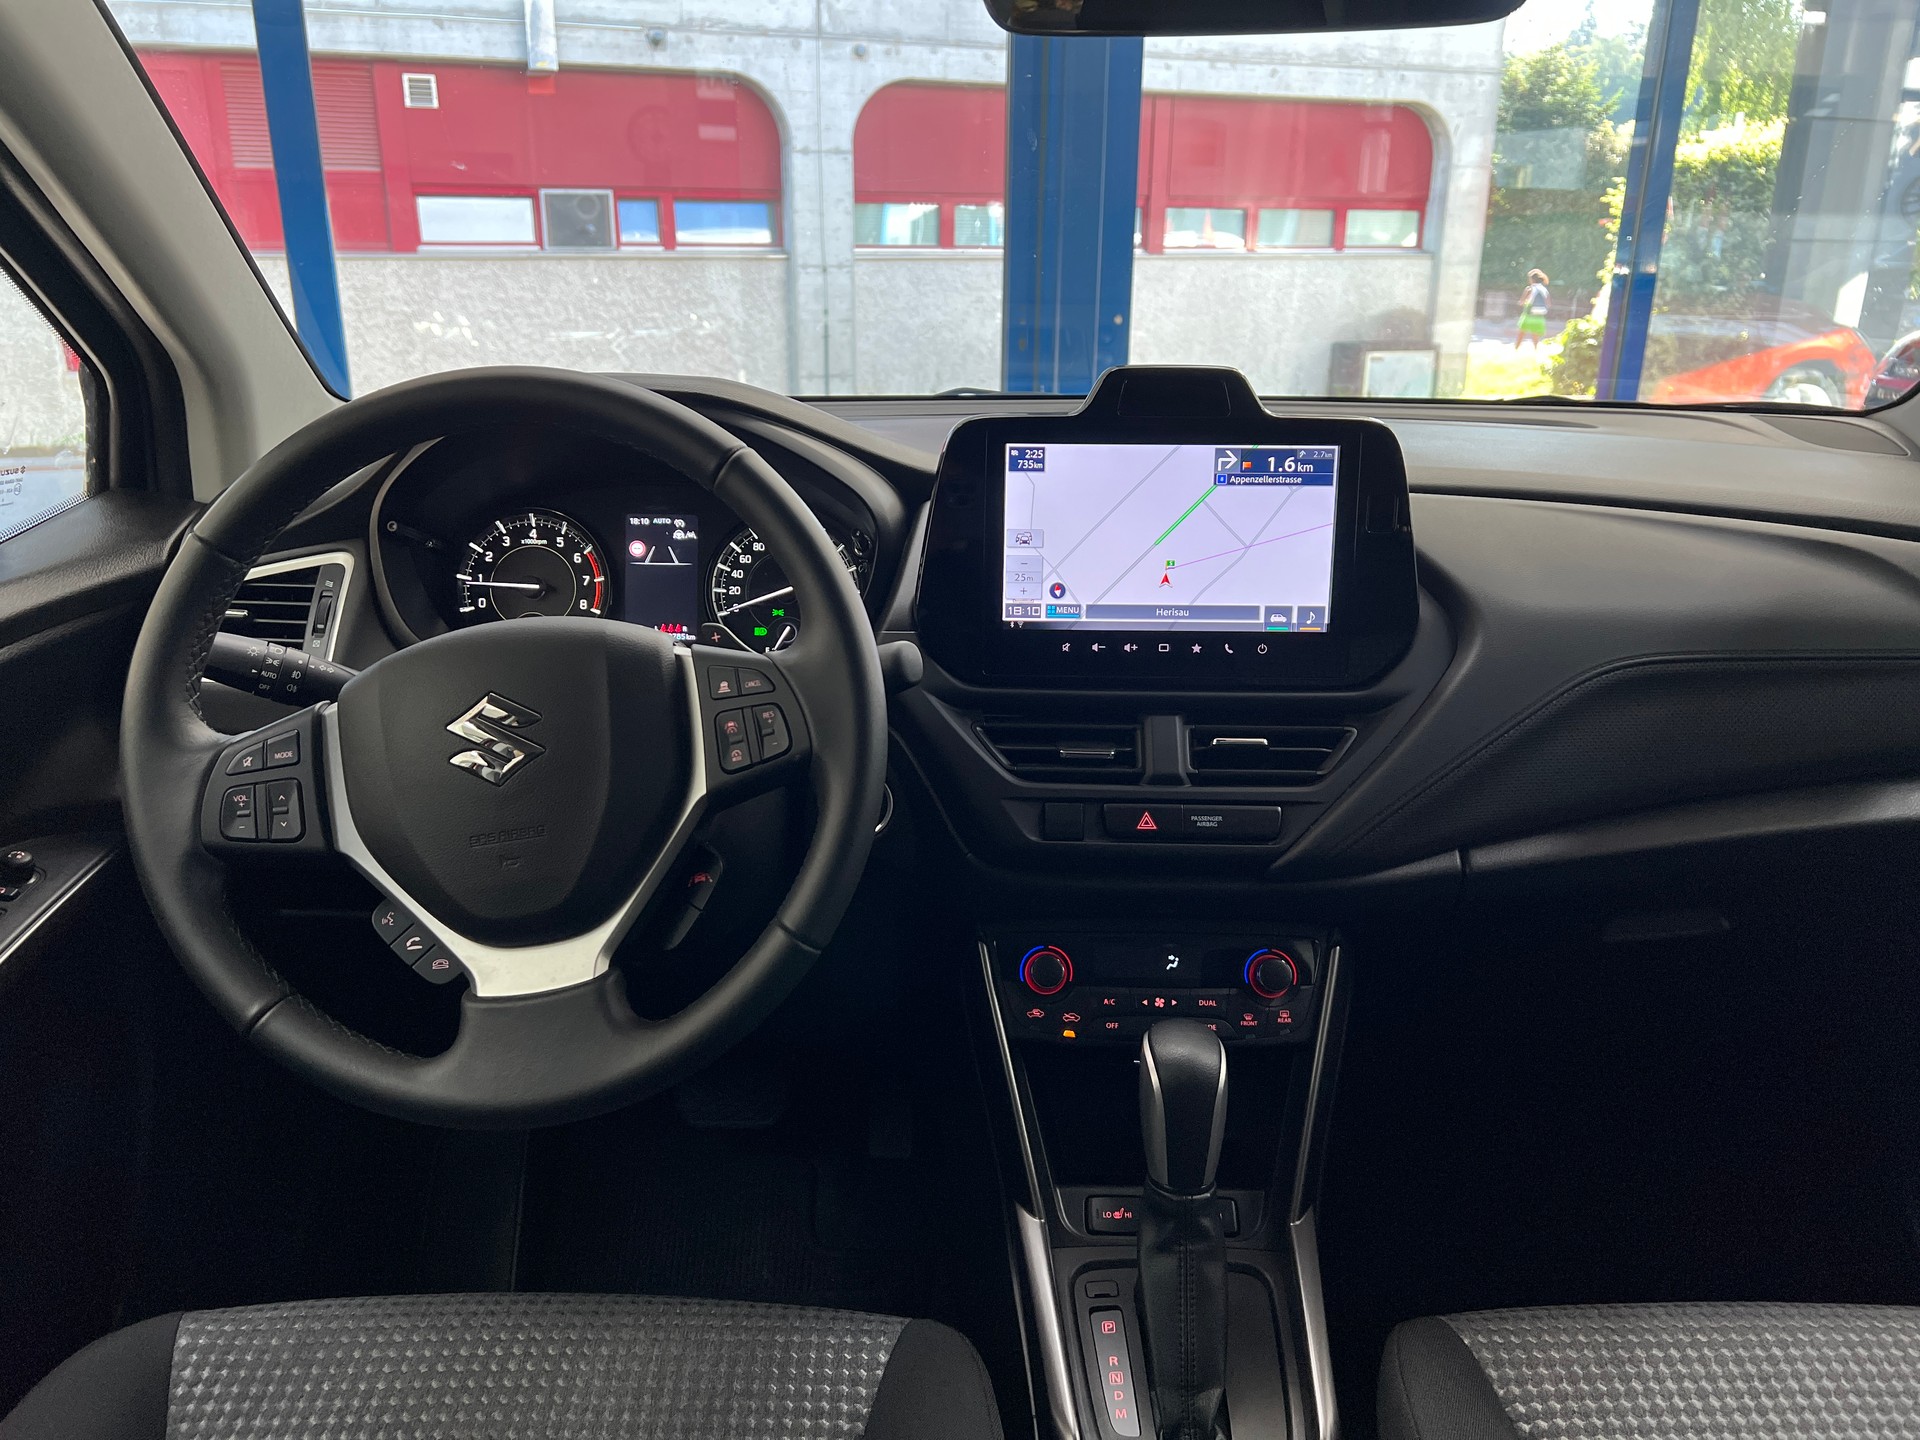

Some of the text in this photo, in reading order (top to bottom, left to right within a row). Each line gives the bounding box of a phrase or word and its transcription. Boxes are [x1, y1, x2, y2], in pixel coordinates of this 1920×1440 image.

[1025, 449, 1044, 459] 2:25
[1229, 475, 1303, 485] Appenzellerstrasse
[629, 517, 650, 525] 18:10
[528, 528, 537, 538] 4
[502, 536, 510, 547] 3
[556, 536, 565, 548] 5
[752, 543, 766, 552] 80
[485, 551, 493, 562] 2
[573, 552, 582, 563] 6
[739, 554, 752, 564] 60
[731, 569, 744, 579] 40
[582, 575, 590, 586] 7
[728, 586, 741, 595] 20
[478, 598, 487, 608] 0
[579, 599, 588, 610] 8
[1008, 606, 1080, 616] 18:10 MENU
[1155, 607, 1190, 617] Herisau
[261, 669, 277, 680] AUTO
[258, 683, 271, 691] OFF
[744, 679, 762, 688] CANCEL
[762, 711, 775, 719] RES
[274, 750, 293, 760] MODE
[233, 794, 248, 802] VOL
[1103, 998, 1116, 1006] A/C
[1198, 999, 1217, 1007] DUAL
[1102, 1211, 1133, 1219] LO HI
[1104, 1322, 1113, 1333] P
[1109, 1356, 1119, 1367] R
[1111, 1373, 1122, 1384] N
[1114, 1390, 1124, 1401] D
[1115, 1408, 1128, 1420] M
